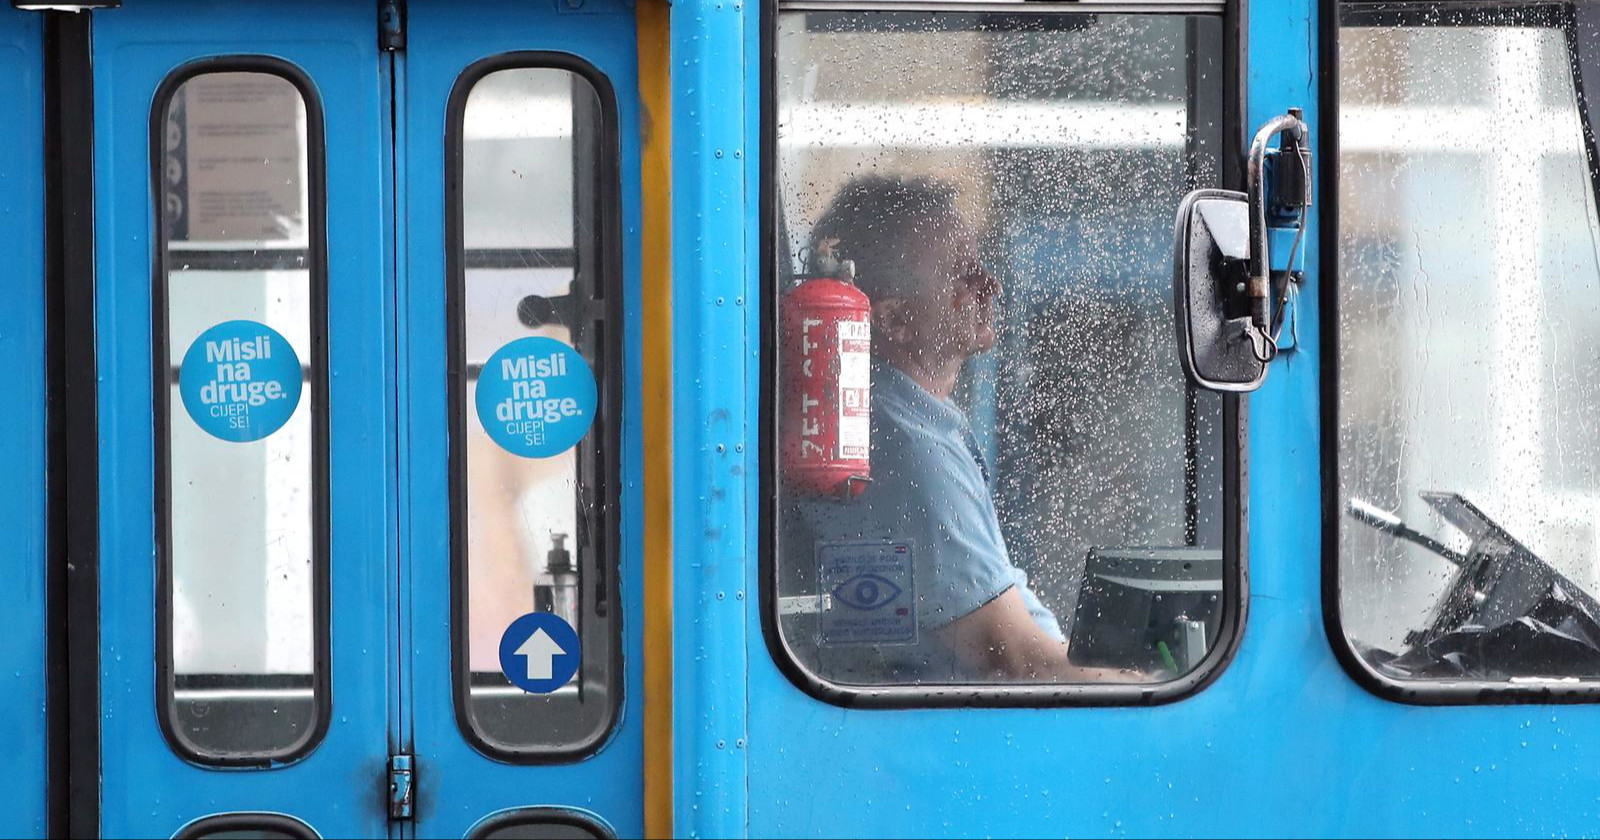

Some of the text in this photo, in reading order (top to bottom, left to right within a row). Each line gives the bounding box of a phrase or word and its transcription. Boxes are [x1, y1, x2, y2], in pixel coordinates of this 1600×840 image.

[206, 335, 271, 363] Misli
[217, 362, 251, 382] na
[501, 353, 566, 380] Misli
[200, 380, 287, 406] druge.
[512, 379, 547, 399] na
[210, 404, 249, 417] CIJEPI
[495, 397, 582, 423] druge.
[229, 416, 249, 429] SE!
[506, 421, 544, 434] CIJEPI
[525, 433, 545, 446] SE!
